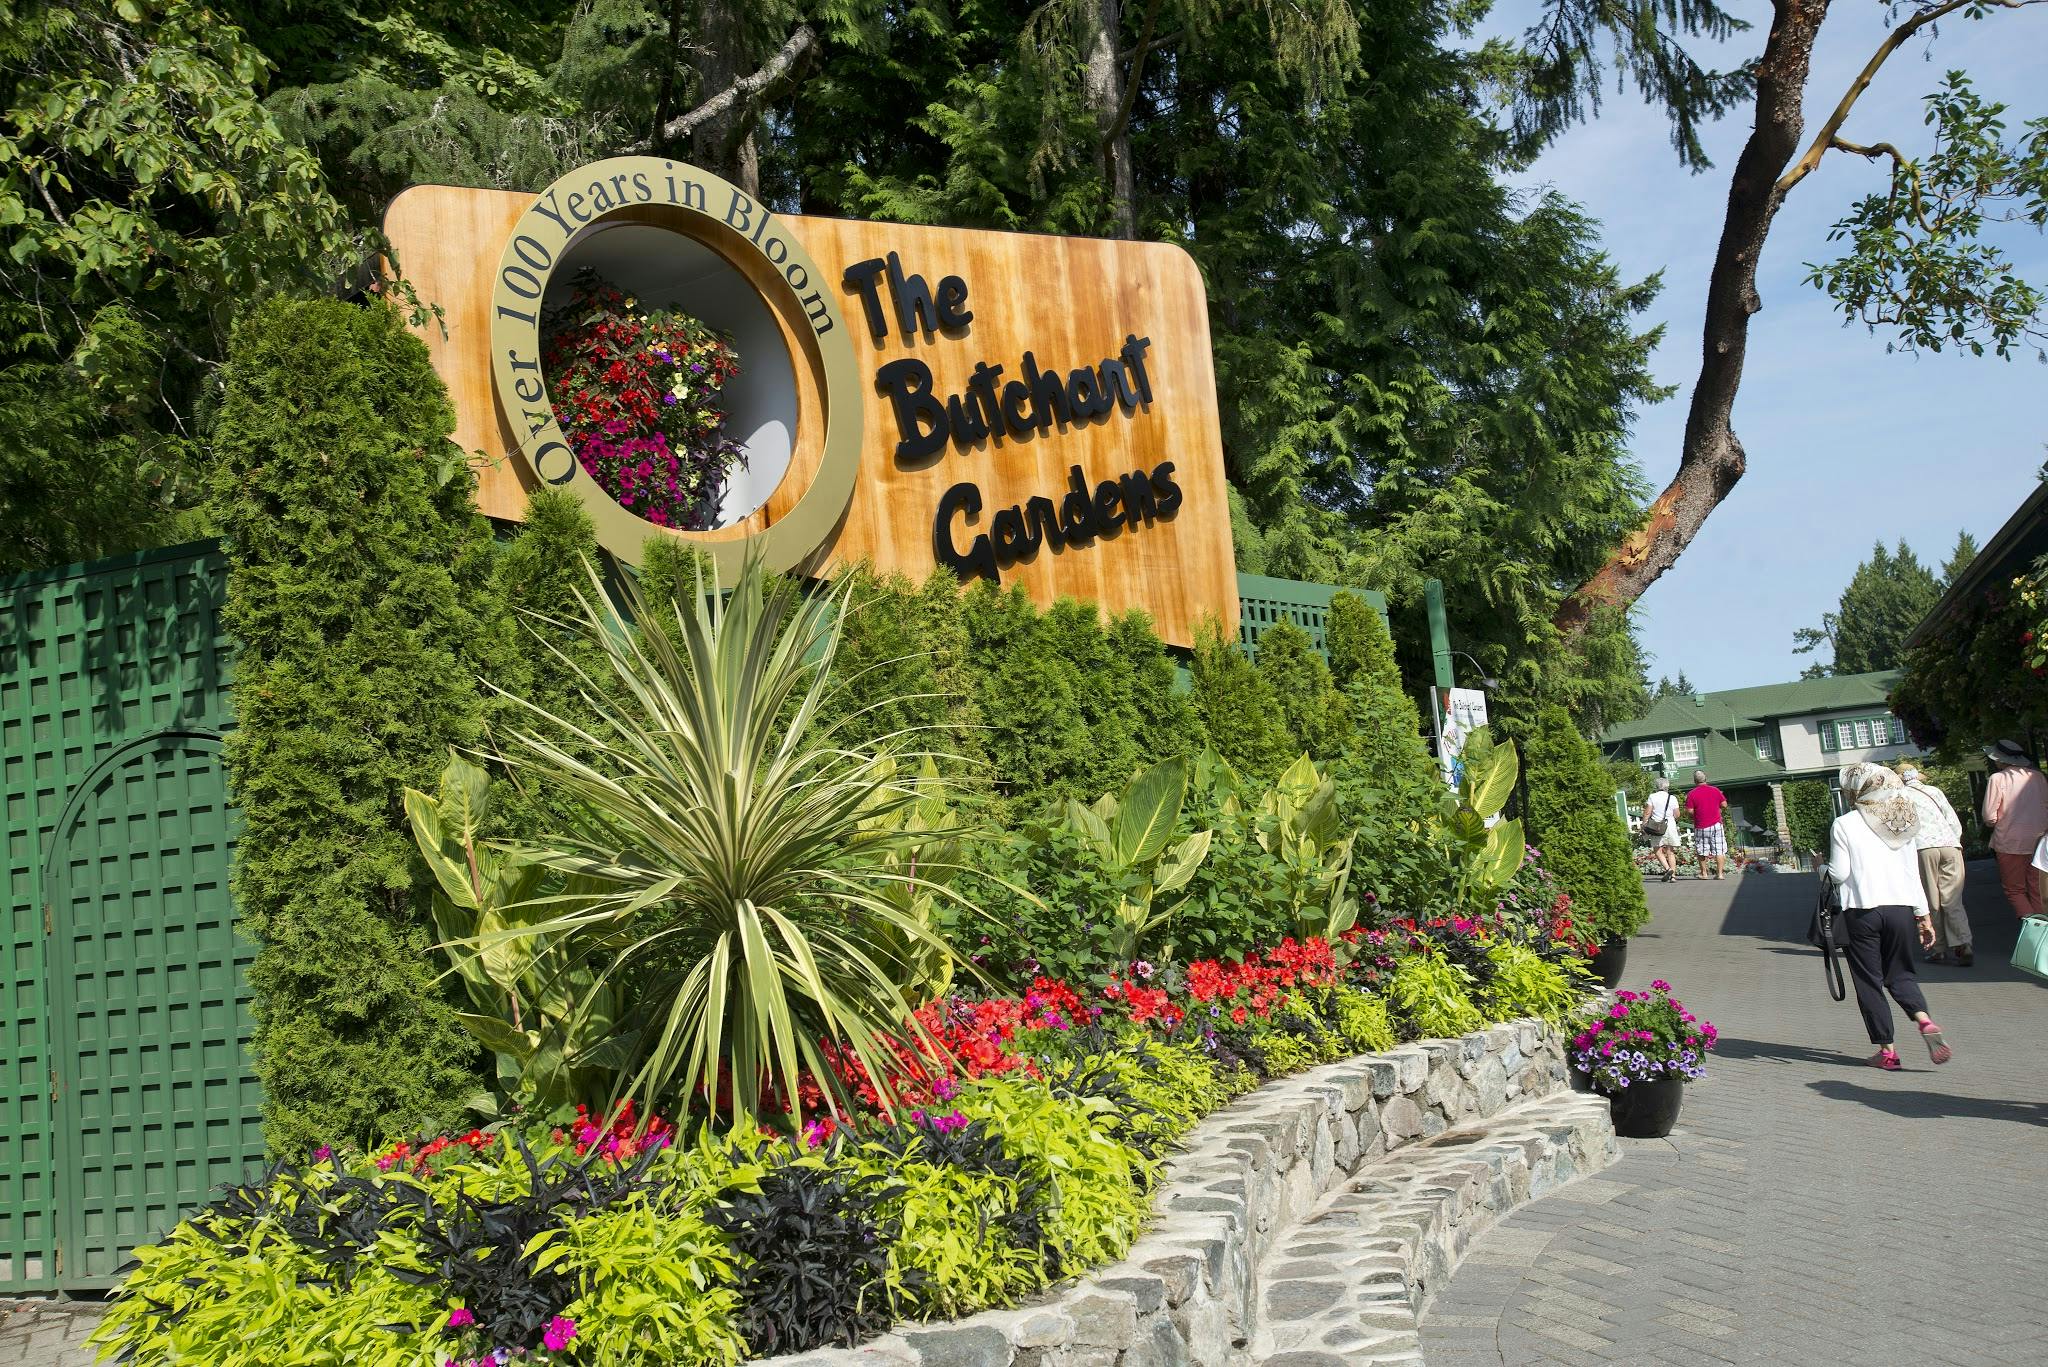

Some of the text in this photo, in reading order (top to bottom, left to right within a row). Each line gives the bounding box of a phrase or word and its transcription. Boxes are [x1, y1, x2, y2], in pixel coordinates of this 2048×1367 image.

[498, 162, 835, 486] Over 100 Years in Bloom
[843, 251, 974, 337] The
[876, 334, 1153, 457] Butchart
[932, 461, 1183, 585] Gardens
